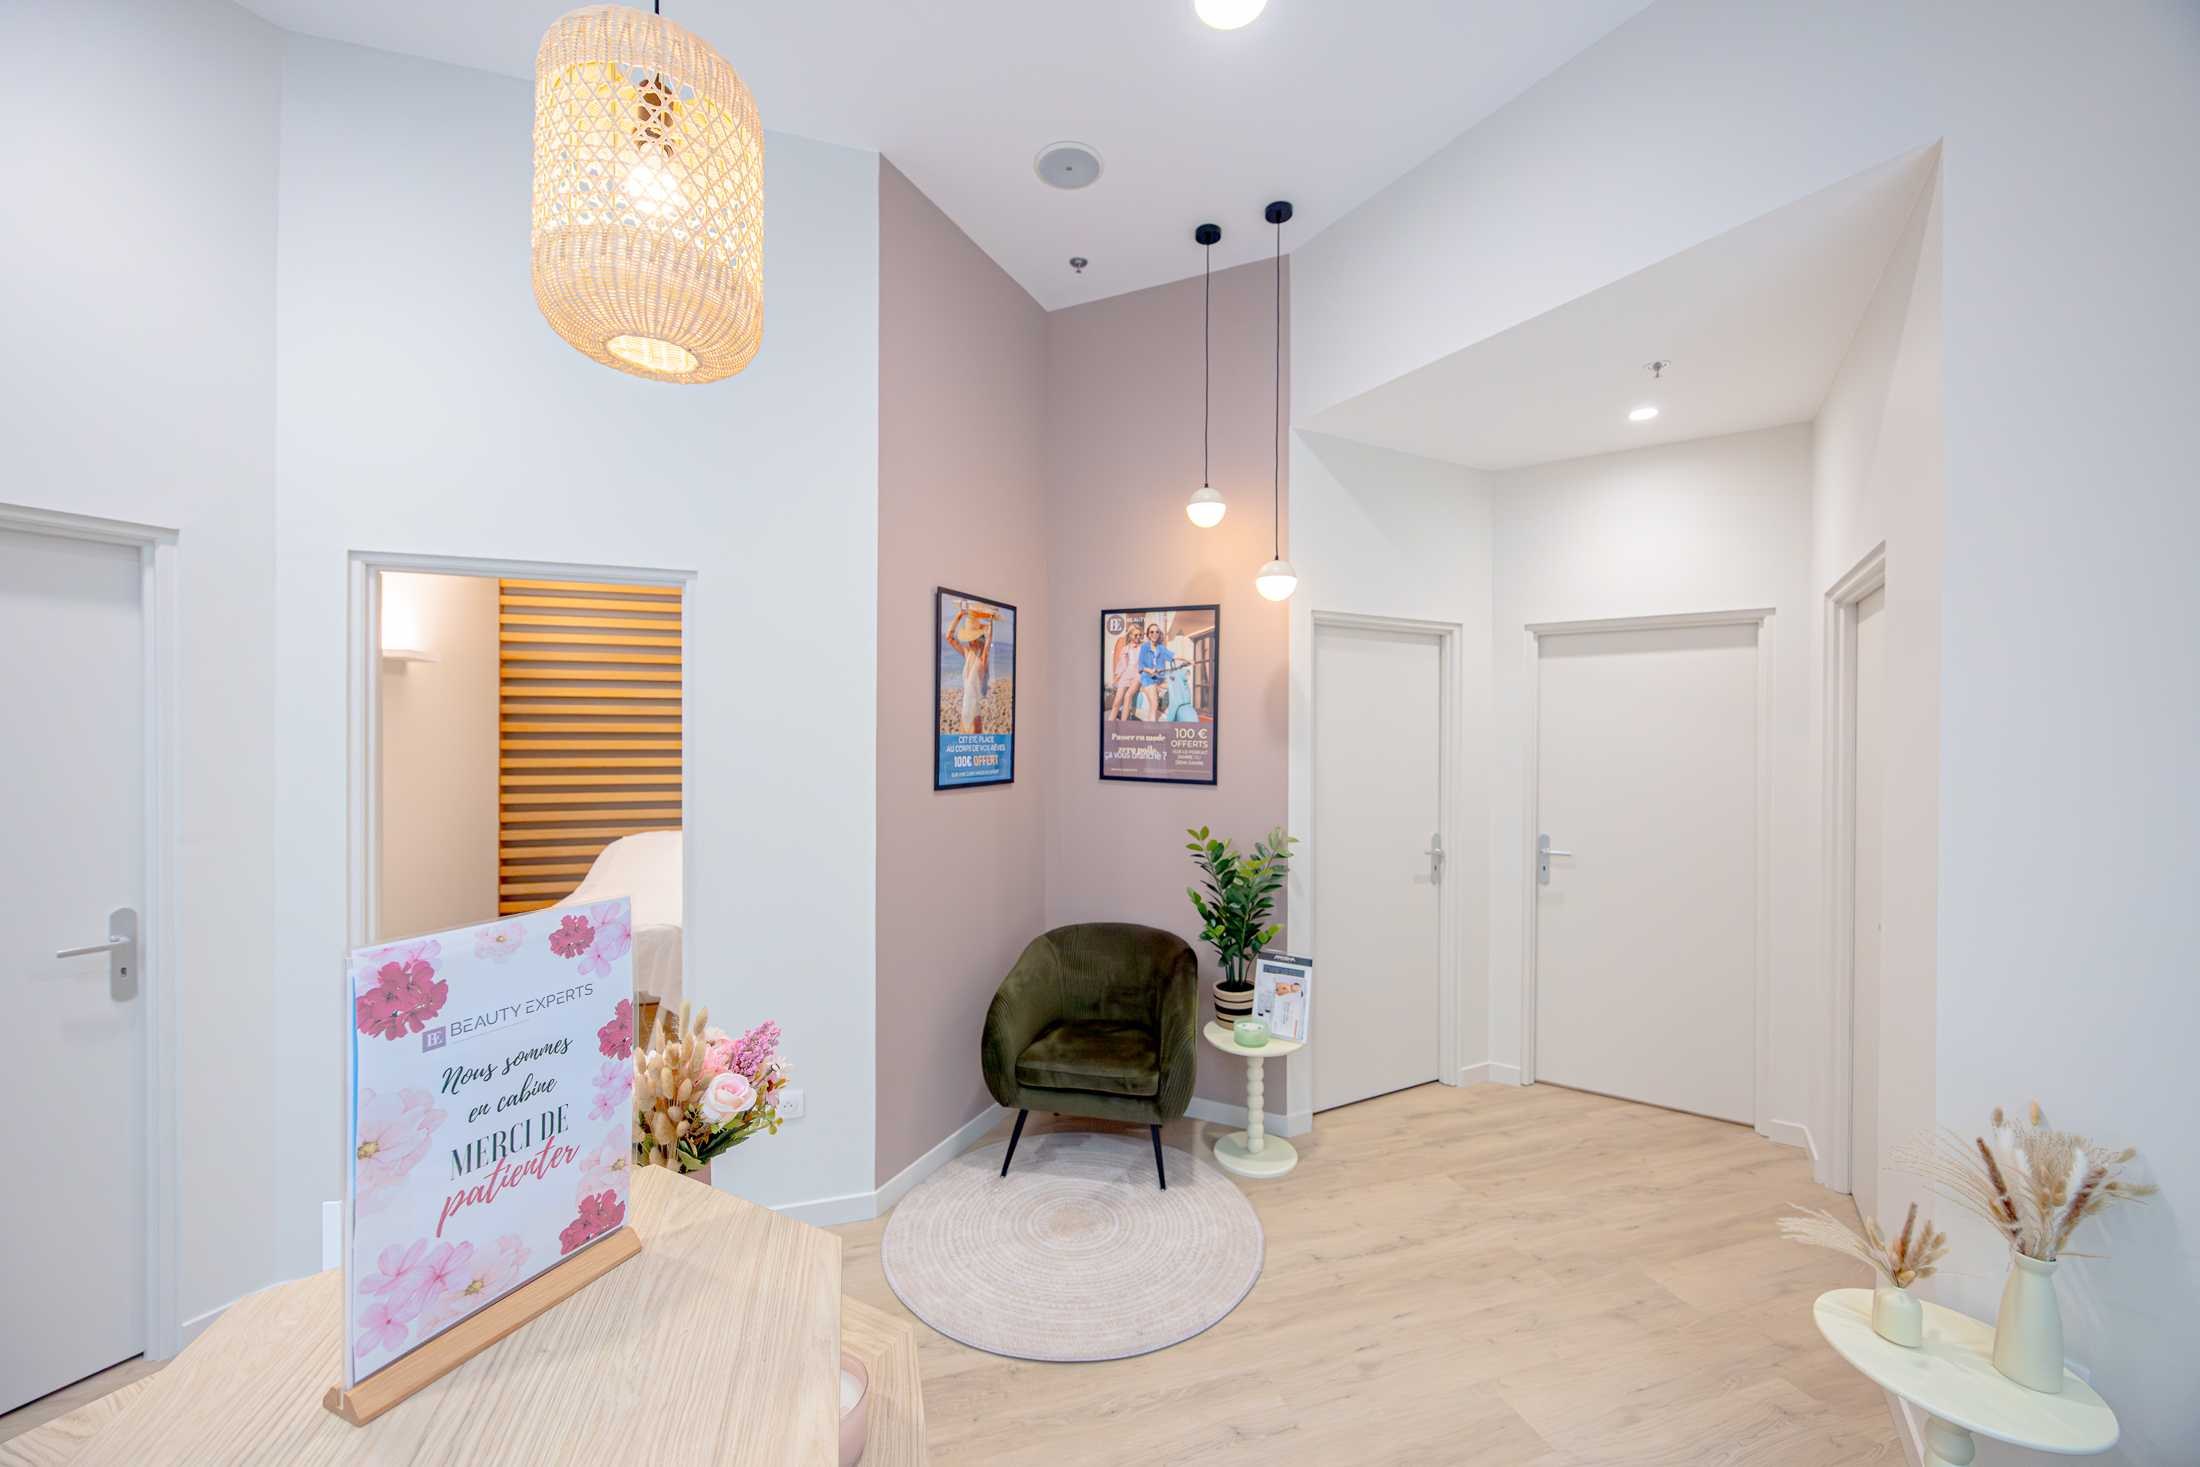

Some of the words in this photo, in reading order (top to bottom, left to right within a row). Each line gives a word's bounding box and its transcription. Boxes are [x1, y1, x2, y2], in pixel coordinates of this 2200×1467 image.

[1170, 740, 1209, 748] OFFERTS
[1174, 728, 1196, 739] 100
[973, 754, 999, 767] OFFERT
[450, 1004, 521, 1037] BEAUTY
[526, 983, 594, 1014] EXPERTS
[440, 1064, 498, 1094] Nous
[501, 1038, 574, 1074] sommes
[467, 1102, 494, 1123] en
[497, 1073, 558, 1113] cabine
[450, 1123, 532, 1181] MERCI
[540, 1103, 570, 1140] DE
[436, 1135, 582, 1238] patienter
